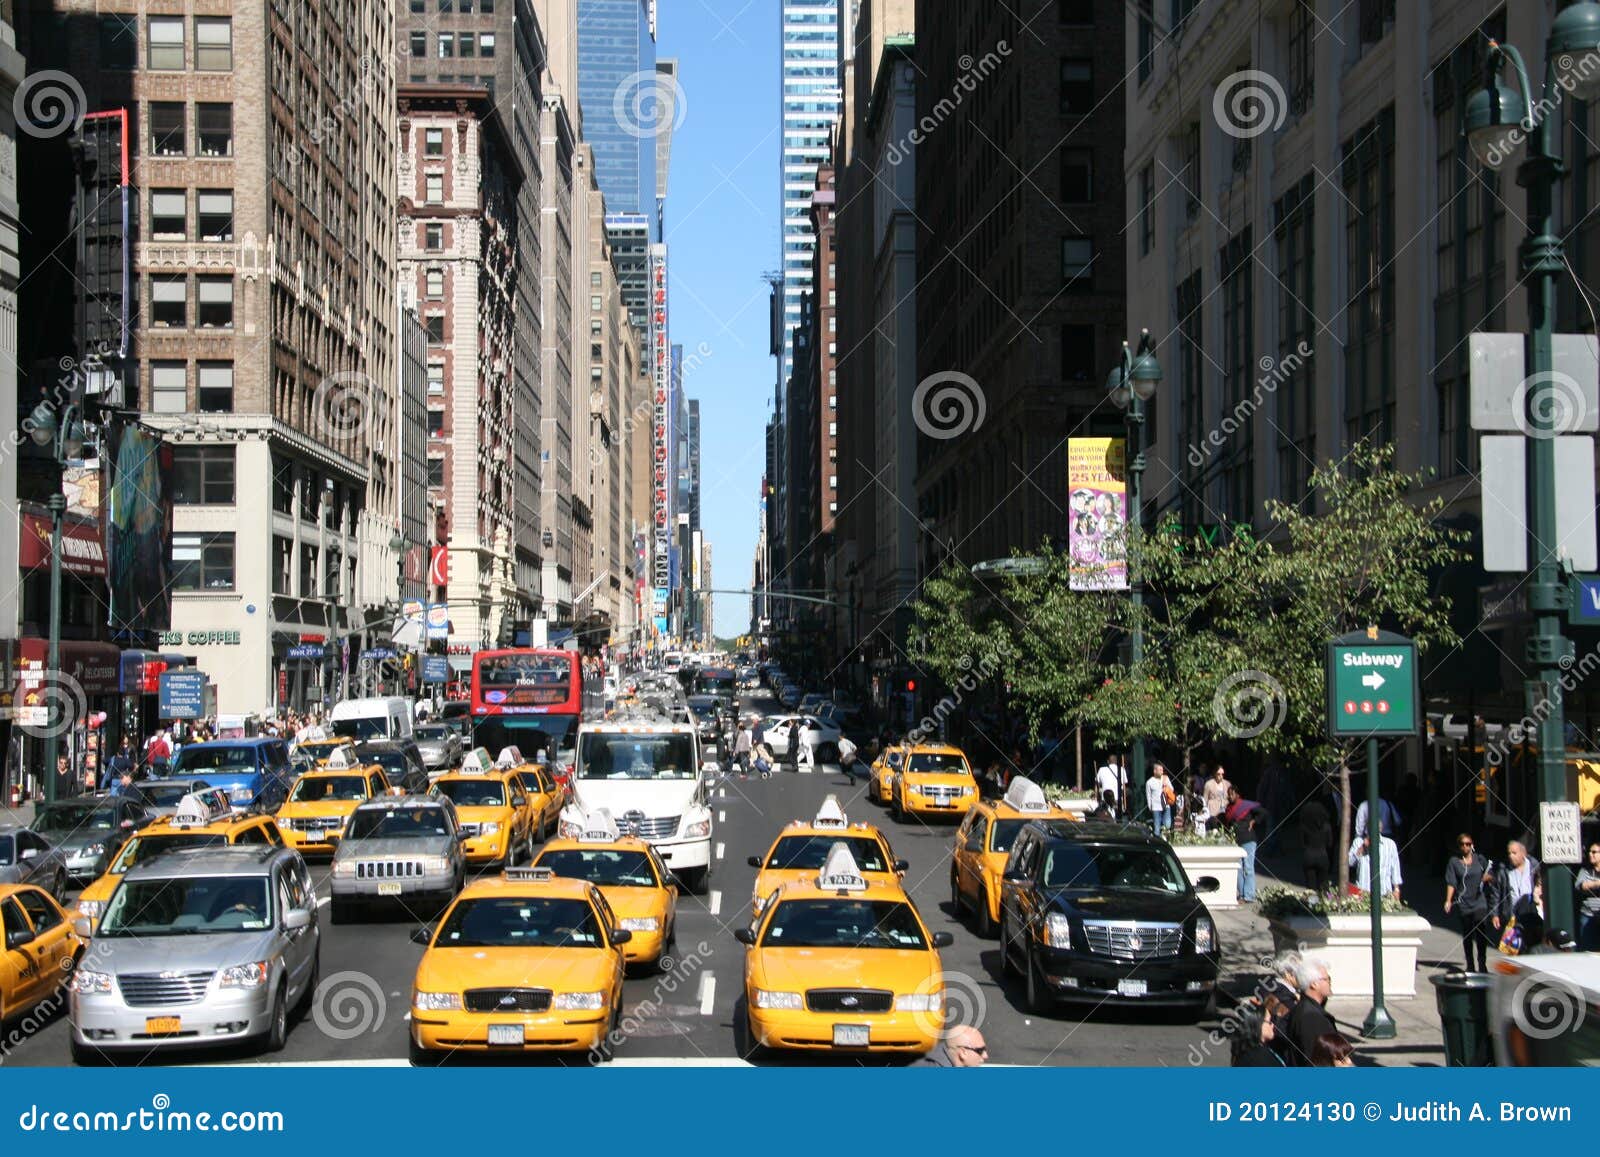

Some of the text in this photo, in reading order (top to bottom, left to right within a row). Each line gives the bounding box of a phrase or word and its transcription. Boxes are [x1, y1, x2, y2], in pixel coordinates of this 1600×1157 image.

[1071, 473, 1089, 482] 25
[188, 631, 241, 645] COFFEE
[1343, 652, 1404, 668] Subway
[1548, 809, 1571, 818] WAIT
[1550, 822, 1570, 831] FOR
[1547, 834, 1575, 844] WALK
[1545, 847, 1576, 857] SIGNAL
